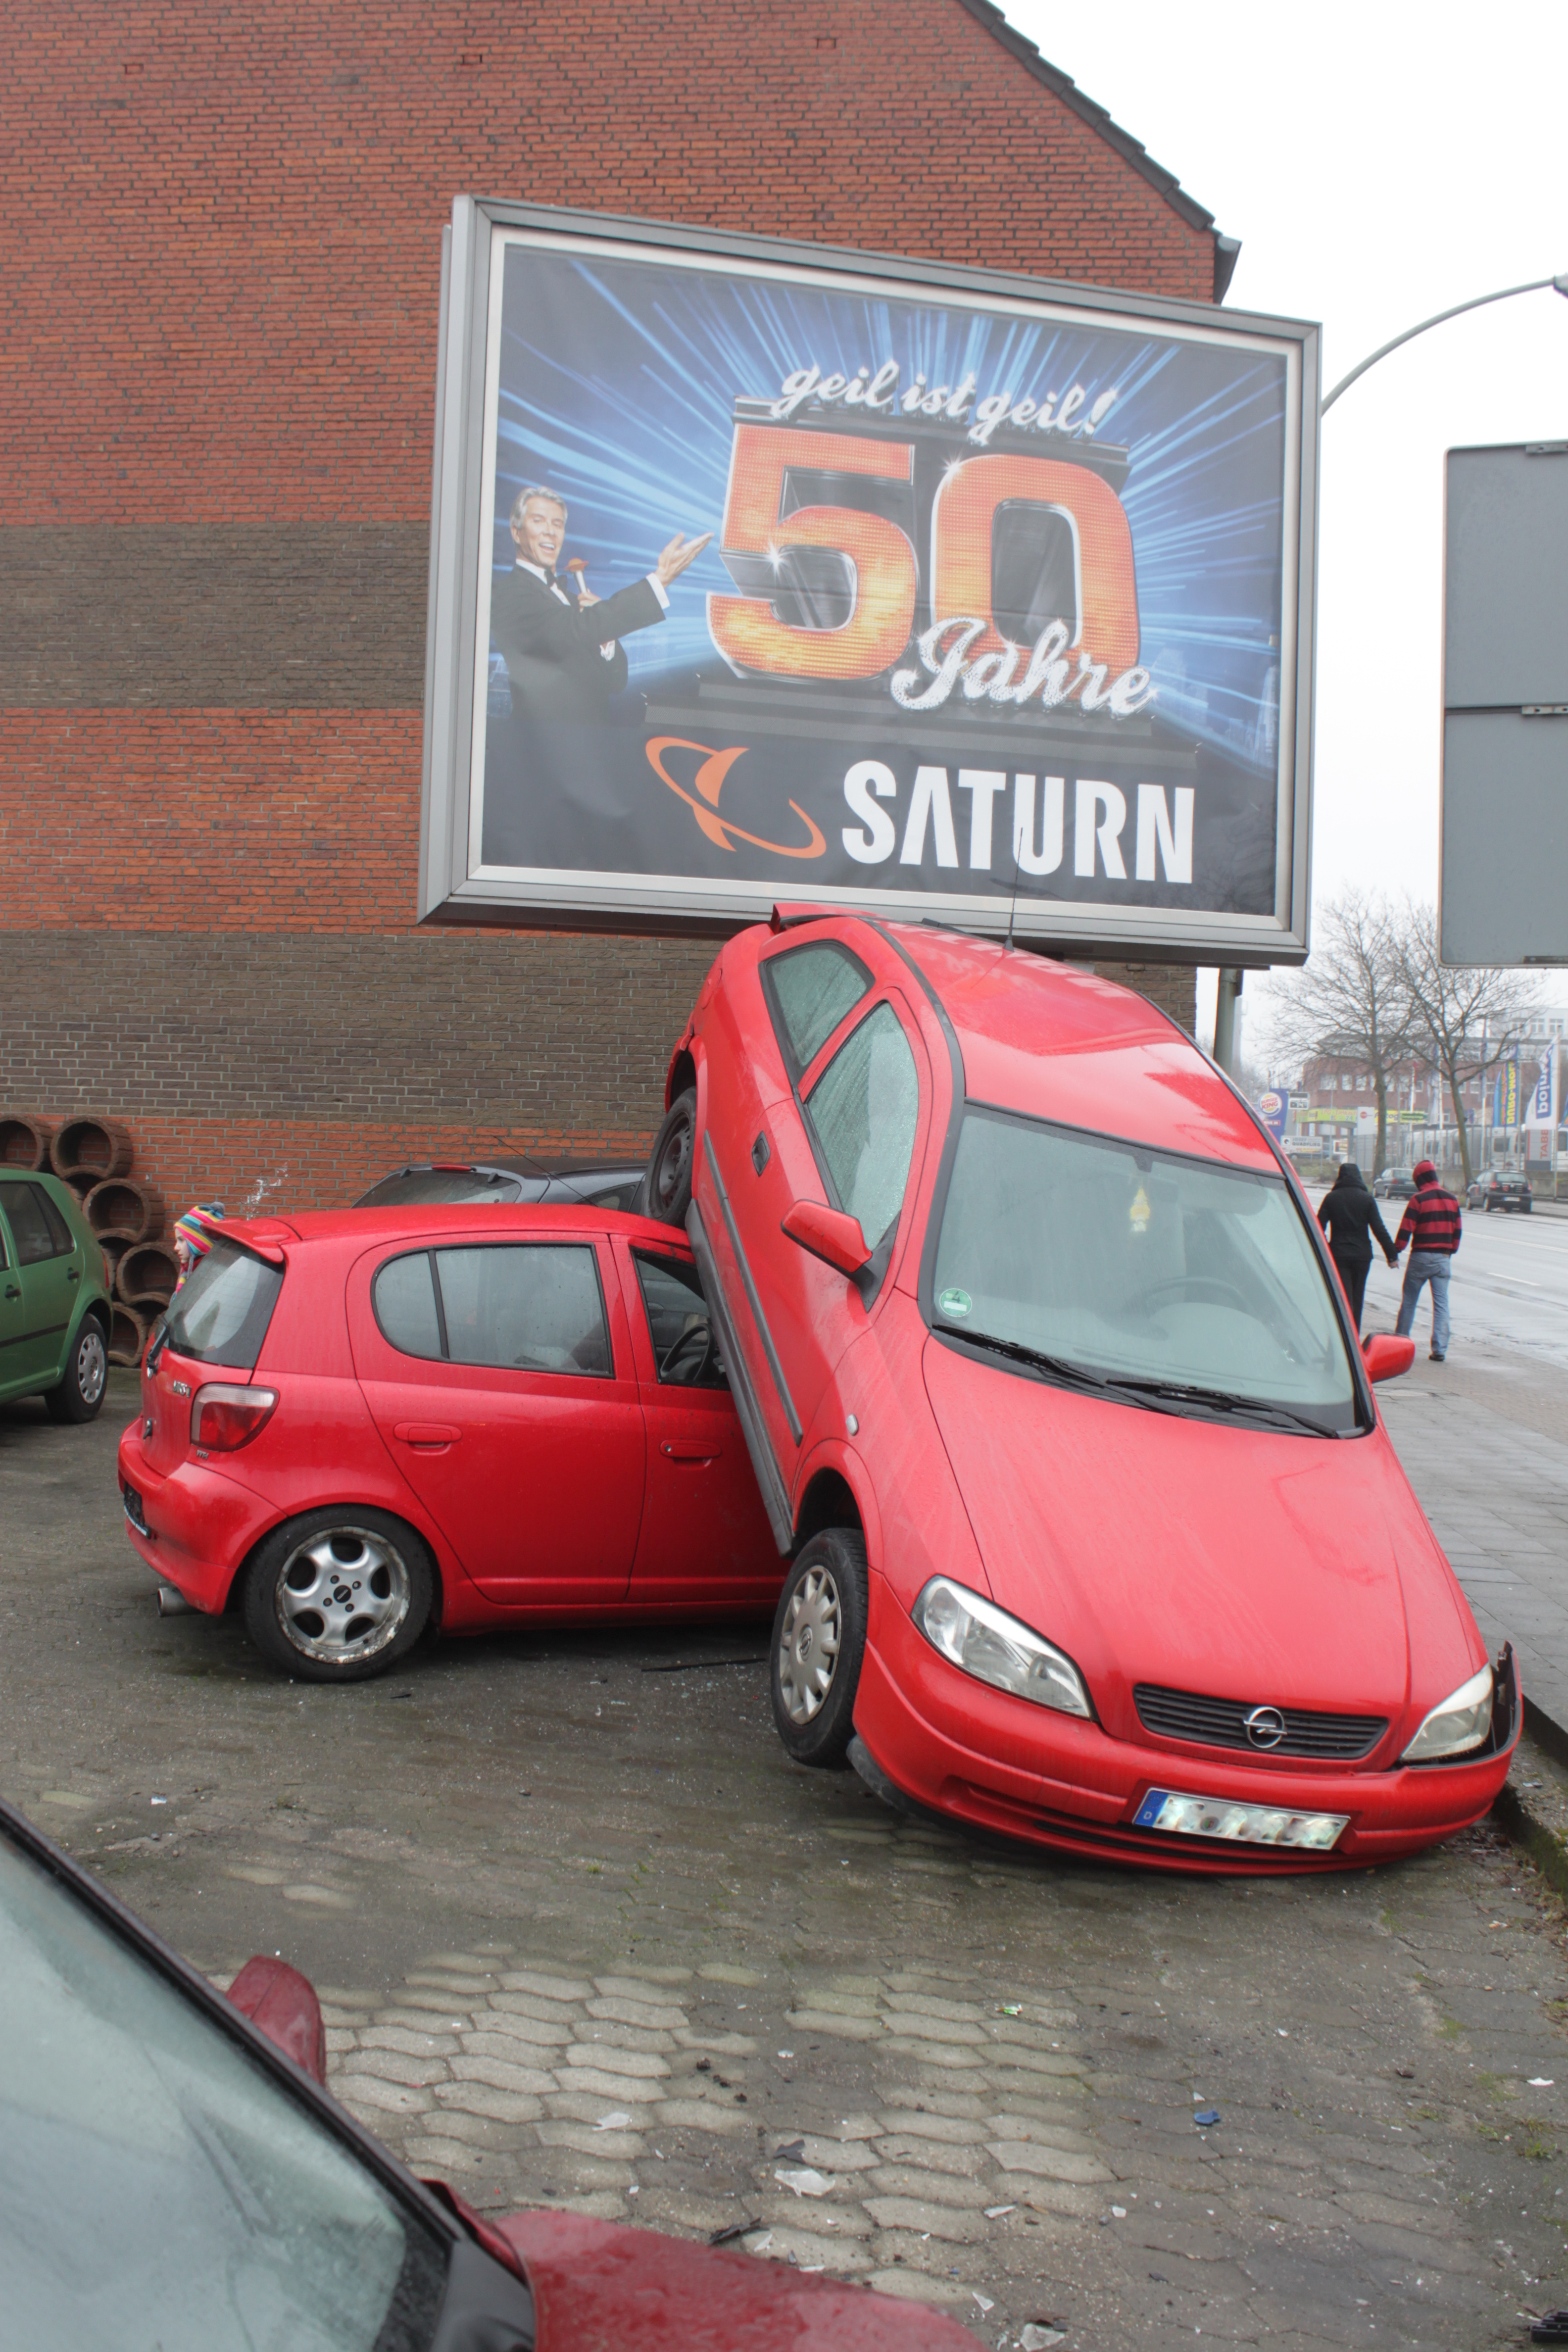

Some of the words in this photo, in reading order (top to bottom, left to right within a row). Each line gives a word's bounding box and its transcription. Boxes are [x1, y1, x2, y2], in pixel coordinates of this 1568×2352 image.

[770, 359, 901, 421] geil
[900, 372, 977, 417] ist
[967, 384, 1120, 446] geil!
[706, 423, 1141, 686] 50
[890, 616, 1157, 721] Jahre
[842, 760, 1195, 884] SATURN
[951, 1290, 961, 1303] 4
[1143, 1811, 1152, 1820] D
